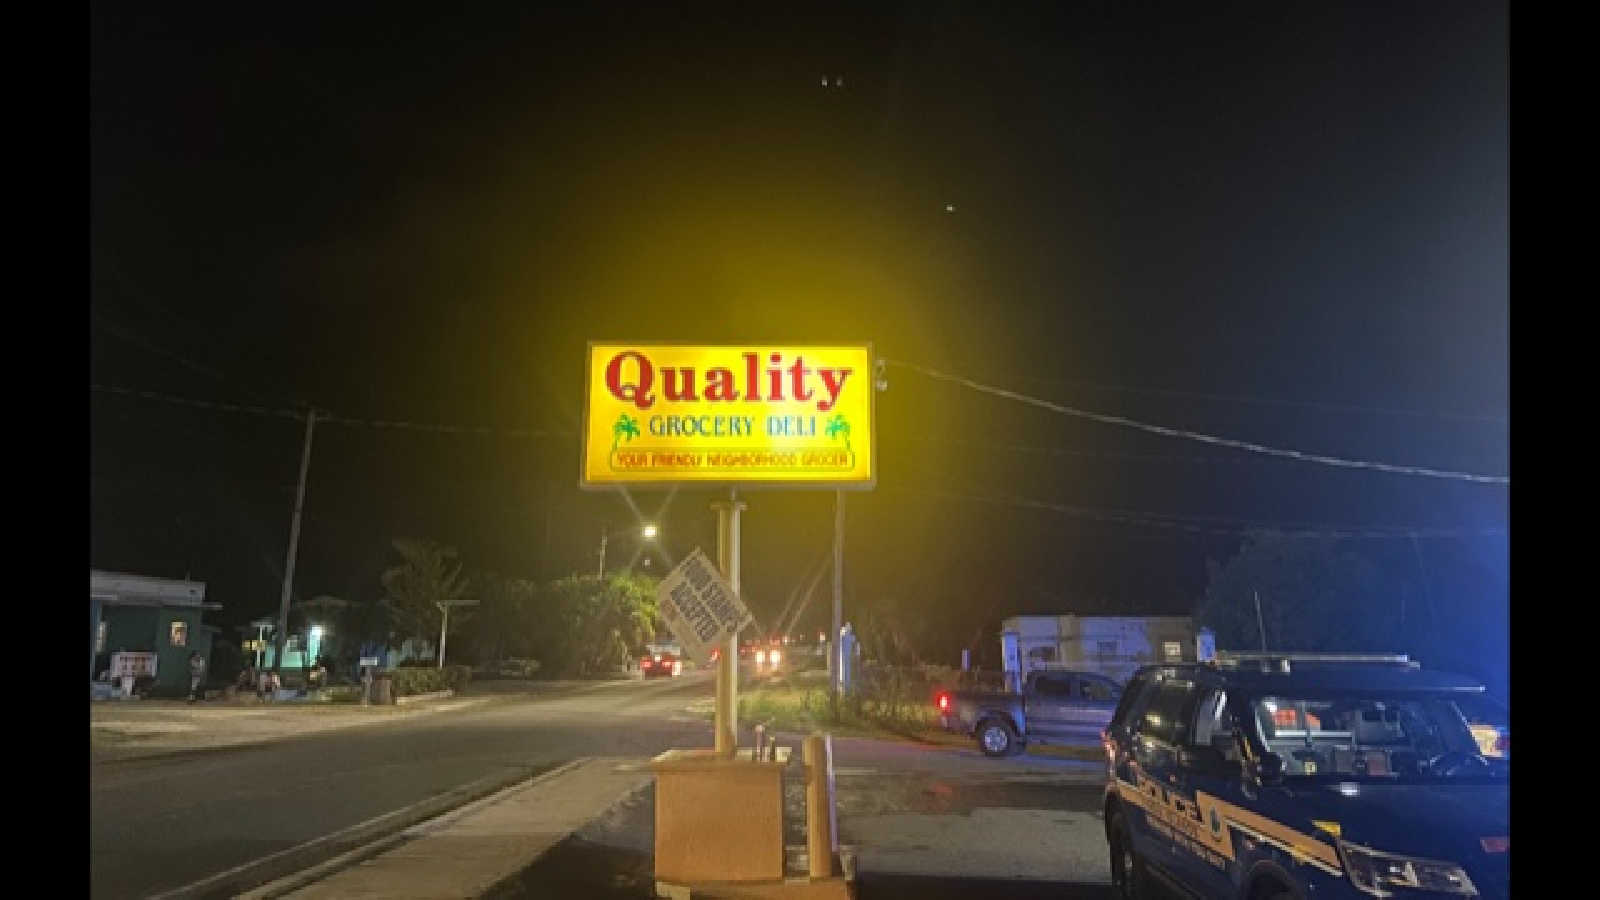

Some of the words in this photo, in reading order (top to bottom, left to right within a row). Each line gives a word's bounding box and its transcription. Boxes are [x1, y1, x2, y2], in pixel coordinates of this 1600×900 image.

[605, 351, 853, 411] Quality
[649, 415, 755, 437] GROCERY
[767, 415, 816, 436] DELI
[617, 453, 647, 467] YOUR
[651, 453, 703, 467] FRIENDLY
